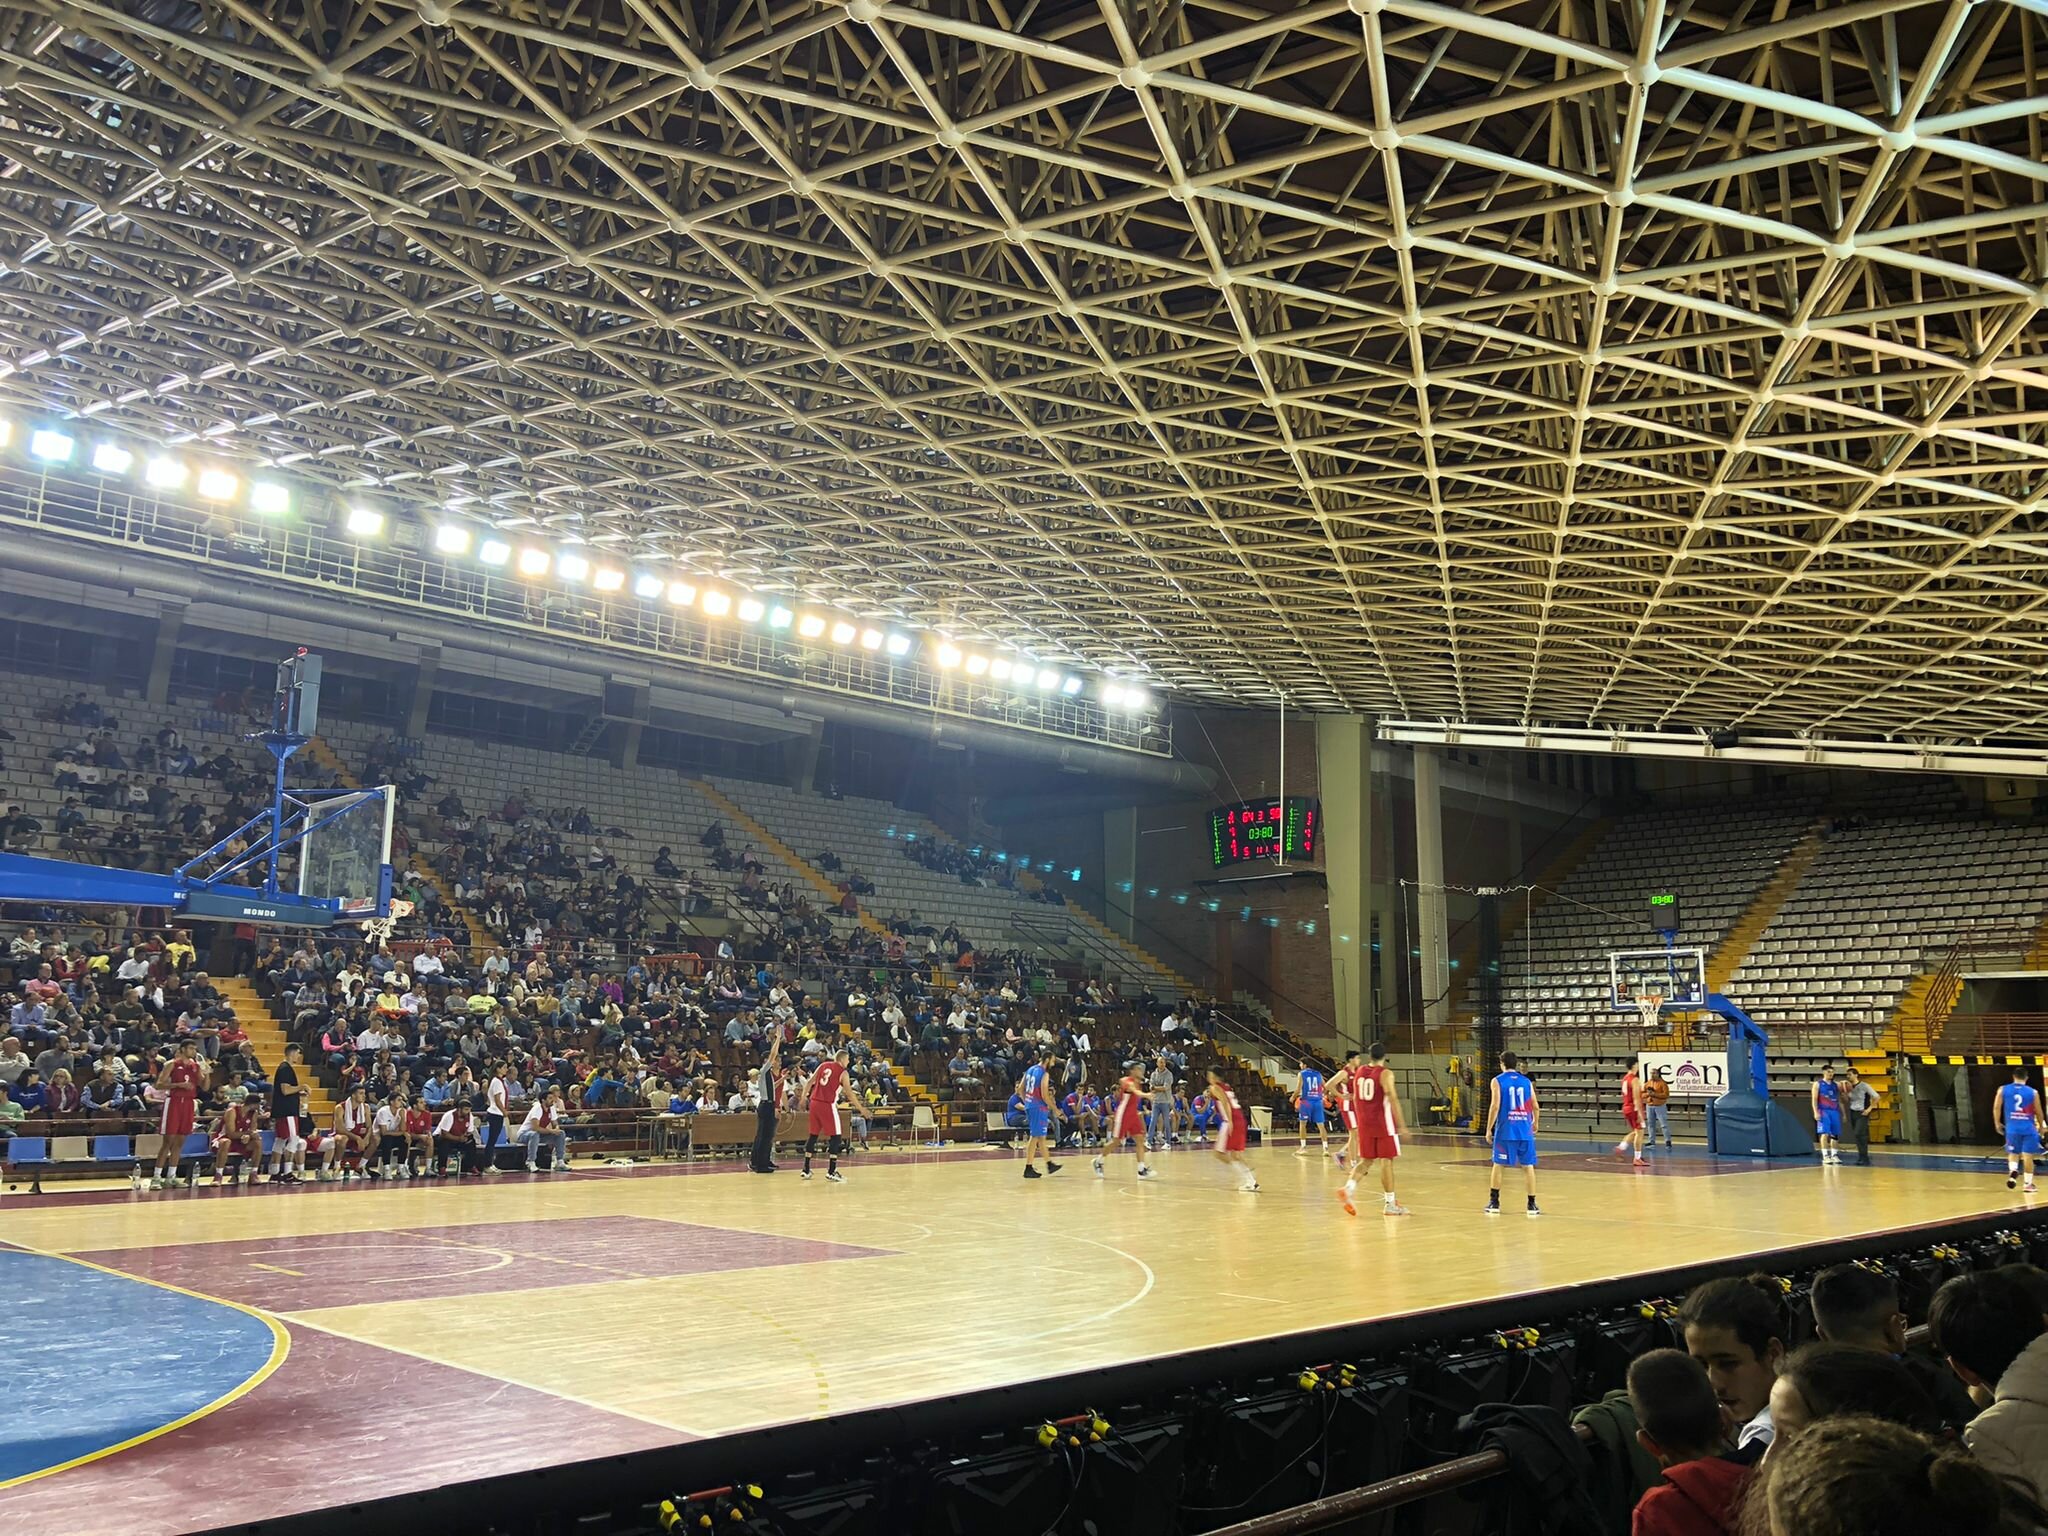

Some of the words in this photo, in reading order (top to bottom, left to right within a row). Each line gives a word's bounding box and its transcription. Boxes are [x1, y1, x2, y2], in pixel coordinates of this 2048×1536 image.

[243, 908, 276, 917] MONDO
[819, 1068, 833, 1086] 3
[1306, 1076, 1318, 1091] 14
[1357, 1077, 1375, 1101] 10
[1508, 1086, 1526, 1111] 11
[2013, 1094, 2023, 1112] 2
